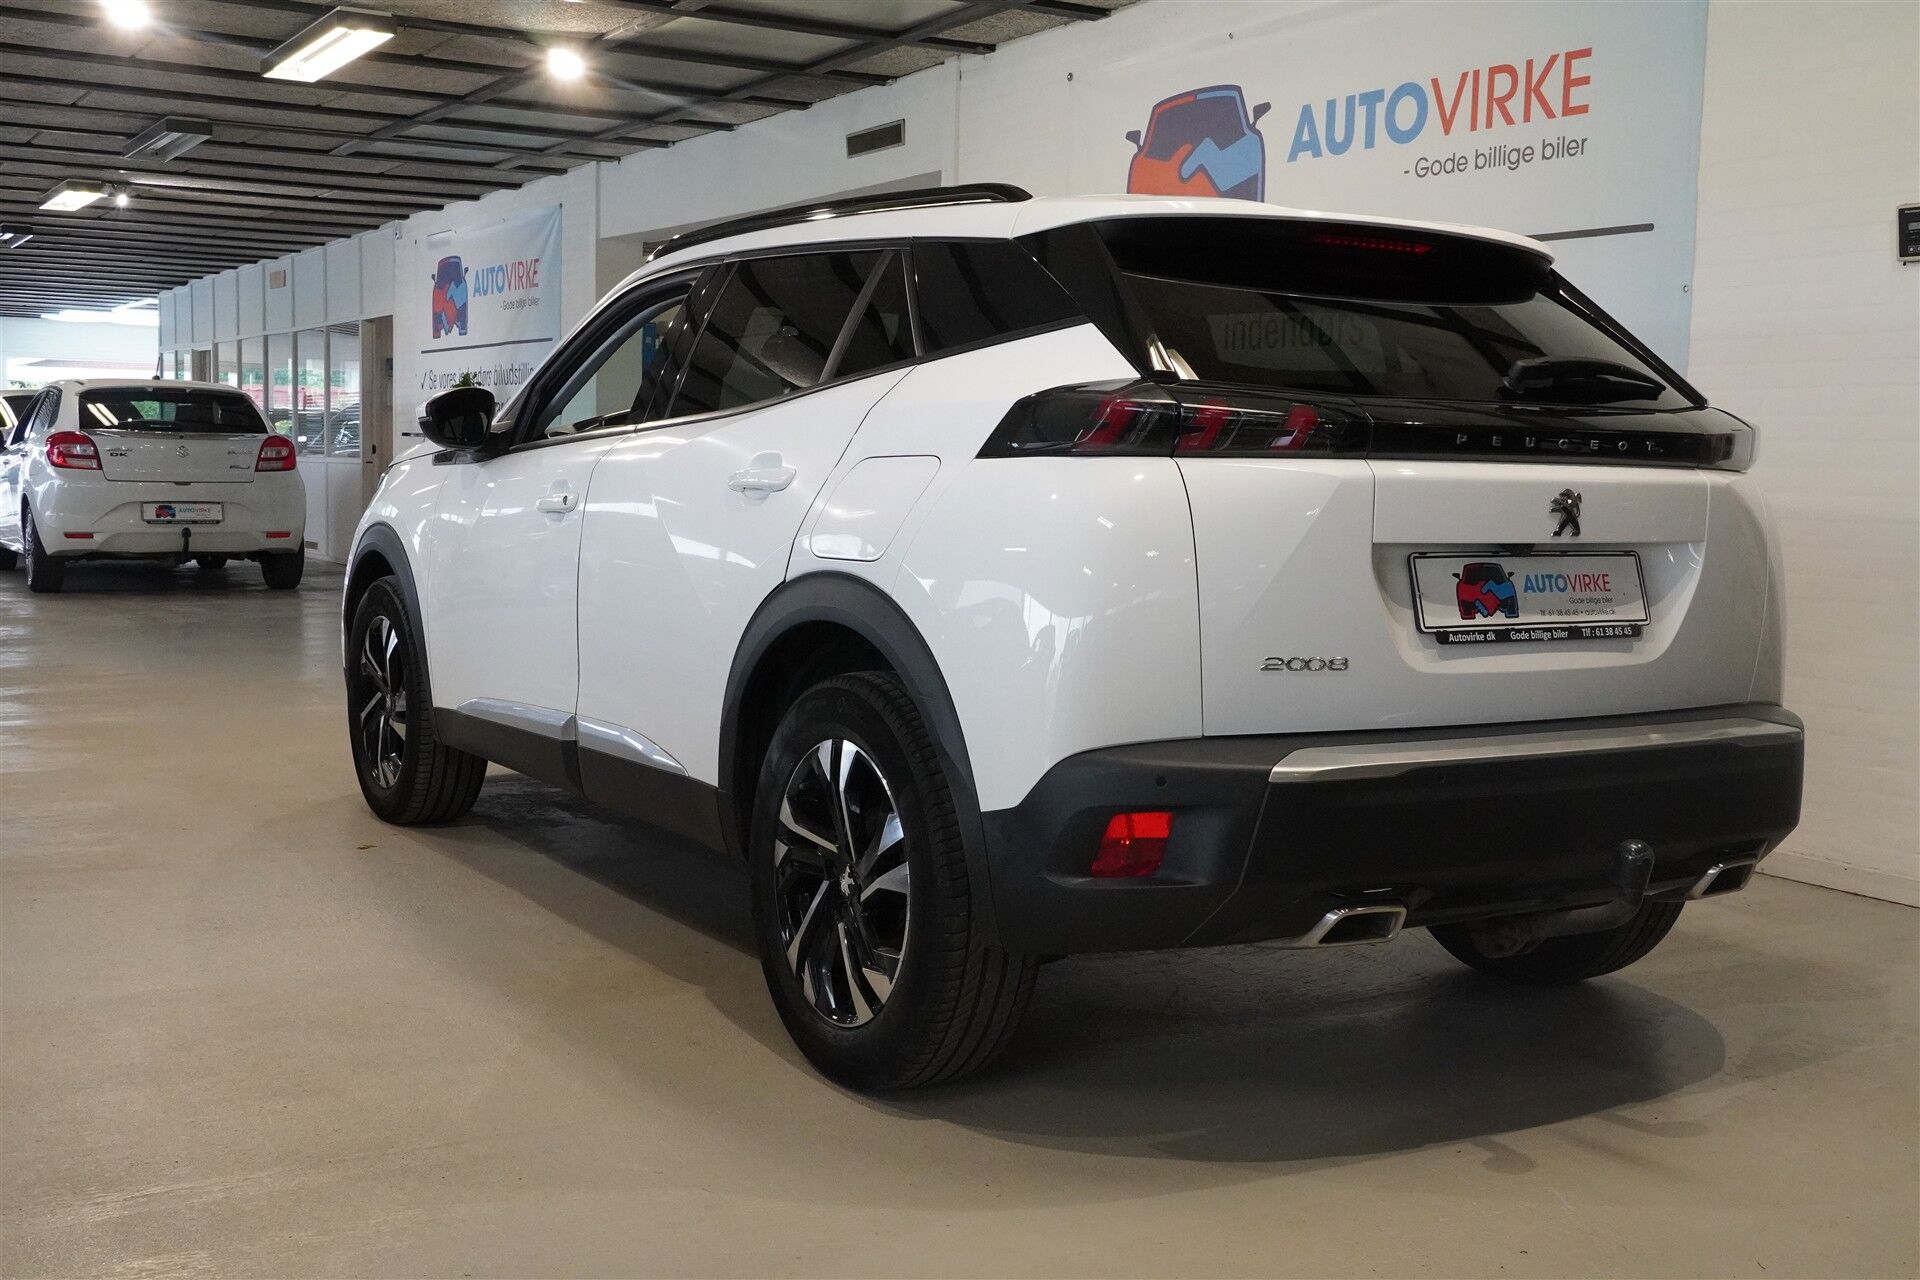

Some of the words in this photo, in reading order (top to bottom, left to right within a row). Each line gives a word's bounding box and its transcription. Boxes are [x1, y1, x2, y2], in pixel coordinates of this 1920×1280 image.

[1287, 47, 1593, 163] AUTOVIRKE
[1414, 153, 1469, 178] Gode
[1474, 145, 1535, 171] billige
[1541, 136, 1588, 161] biler
[473, 258, 540, 297] AUTOVIRKE
[428, 369, 437, 390] Se
[439, 371, 457, 389] vores
[1456, 433, 1663, 453] PEUGEOT
[1523, 573, 1612, 593] AUTOVIRKE
[1448, 632, 1485, 642] Autovirke
[1510, 631, 1530, 640] Gode
[1531, 630, 1551, 641] billige
[1552, 629, 1568, 639] biler
[1595, 628, 1604, 636] 61
[1605, 627, 1613, 636] 38
[1614, 627, 1623, 636] 45
[1624, 626, 1632, 635] 45
[1260, 656, 1349, 671] 2008
